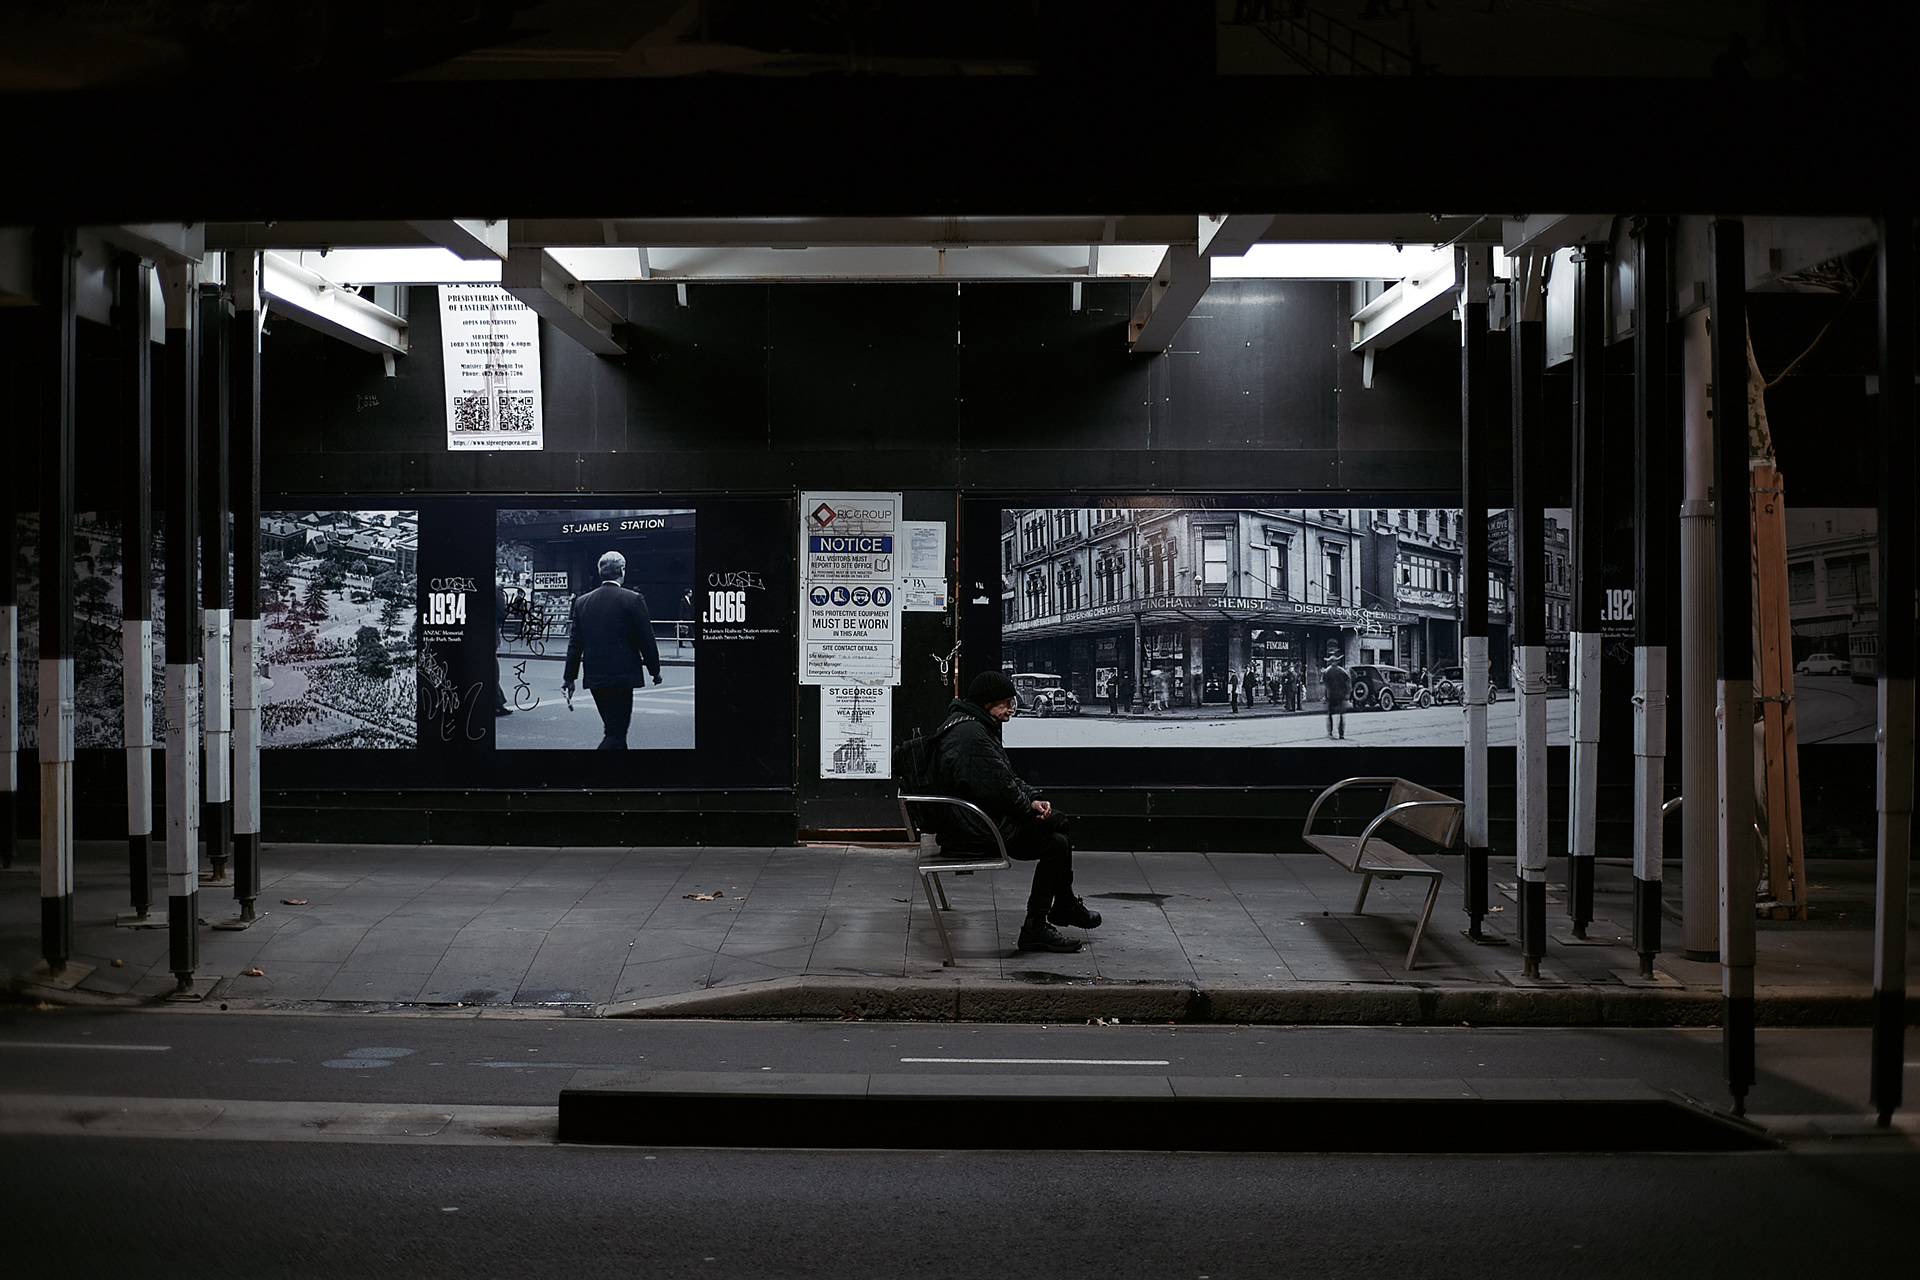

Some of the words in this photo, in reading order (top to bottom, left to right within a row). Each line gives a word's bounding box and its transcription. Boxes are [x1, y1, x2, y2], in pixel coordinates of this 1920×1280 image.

[575, 522, 610, 532] JAMES
[620, 518, 665, 530] STATION
[820, 538, 882, 552] NOTICE
[423, 593, 466, 624] c.1934
[702, 591, 746, 622] c.1966
[1066, 608, 1093, 621] DISPENSING
[1294, 604, 1358, 616] DISPENSING
[1600, 589, 1636, 621] c.192
[812, 618, 840, 628] MUST
[844, 618, 856, 628] BE
[858, 618, 888, 629] WORN
[1266, 640, 1289, 650] FINCHAM
